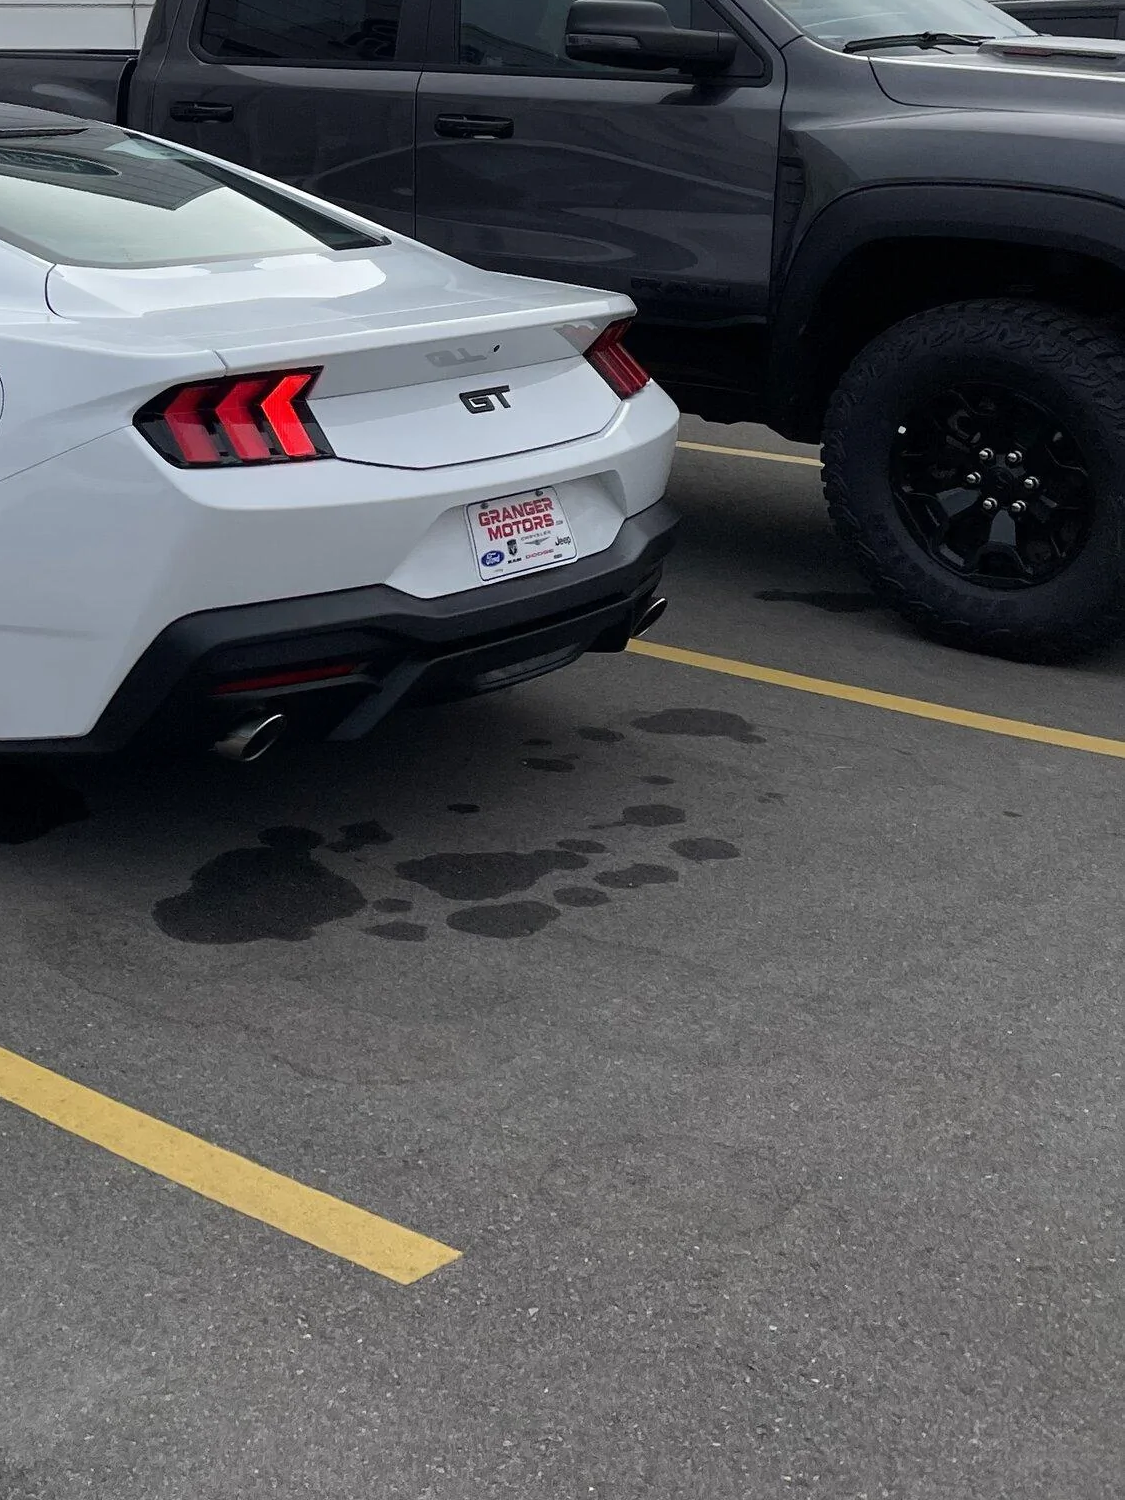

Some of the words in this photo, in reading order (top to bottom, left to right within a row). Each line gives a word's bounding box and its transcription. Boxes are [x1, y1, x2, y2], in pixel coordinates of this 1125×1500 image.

[458, 384, 512, 415] GT
[478, 497, 554, 526] GRANGER
[487, 513, 554, 541] MOTORS
[554, 535, 572, 546] Jeep
